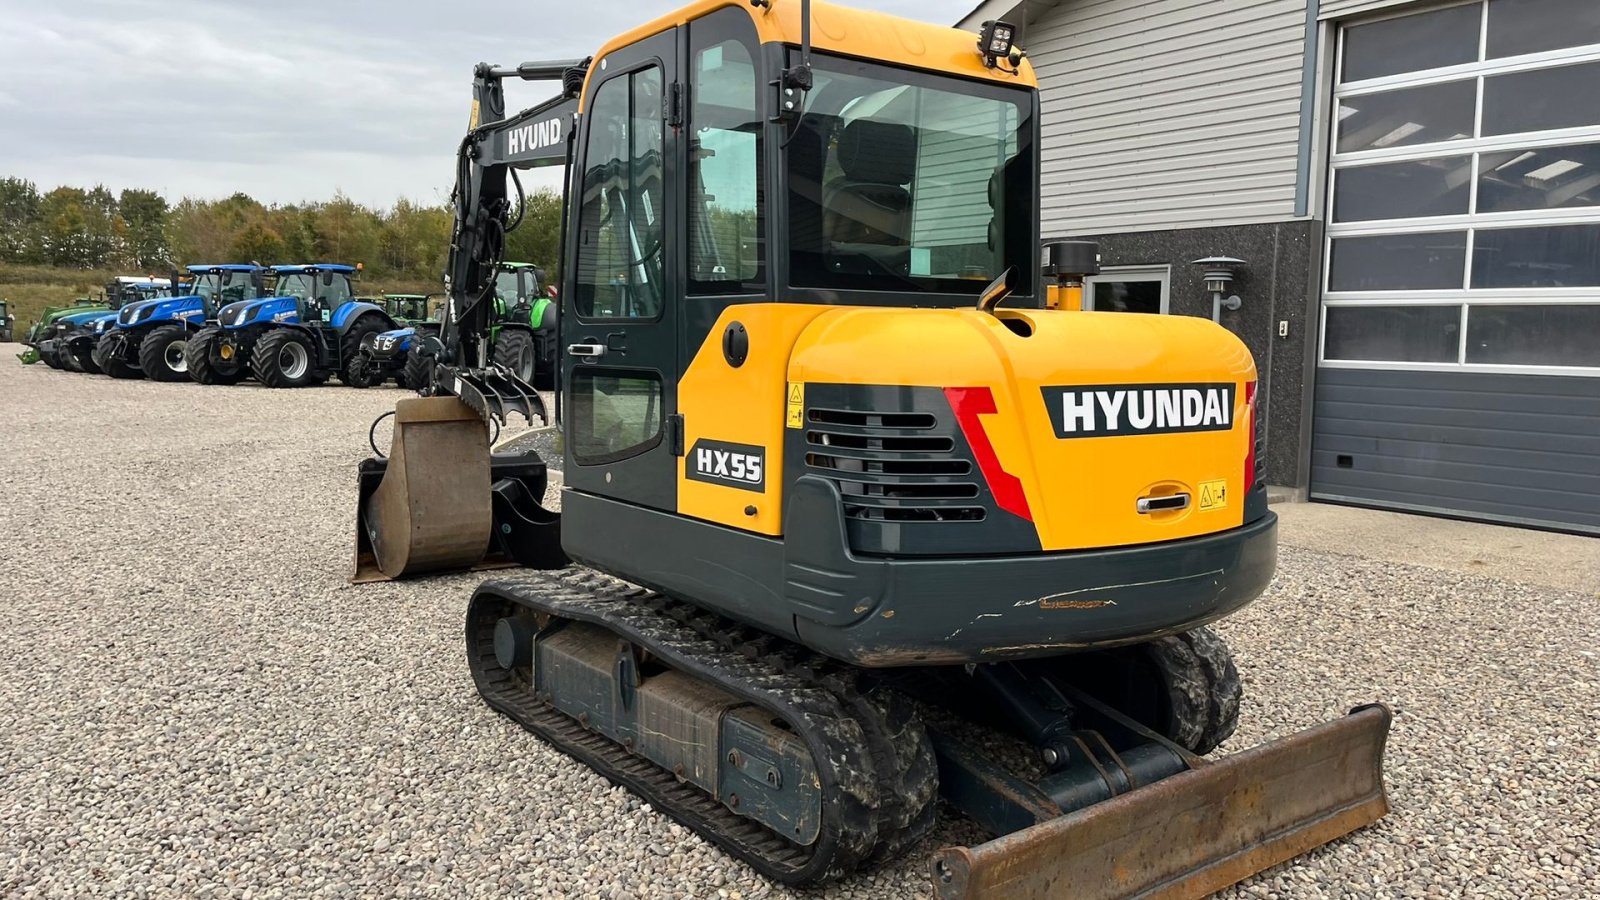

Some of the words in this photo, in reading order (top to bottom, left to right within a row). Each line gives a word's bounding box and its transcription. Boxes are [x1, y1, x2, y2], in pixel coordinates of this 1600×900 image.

[508, 118, 561, 155] HYUND
[1062, 388, 1229, 432] HYUNDAI
[697, 448, 761, 481] HX55
